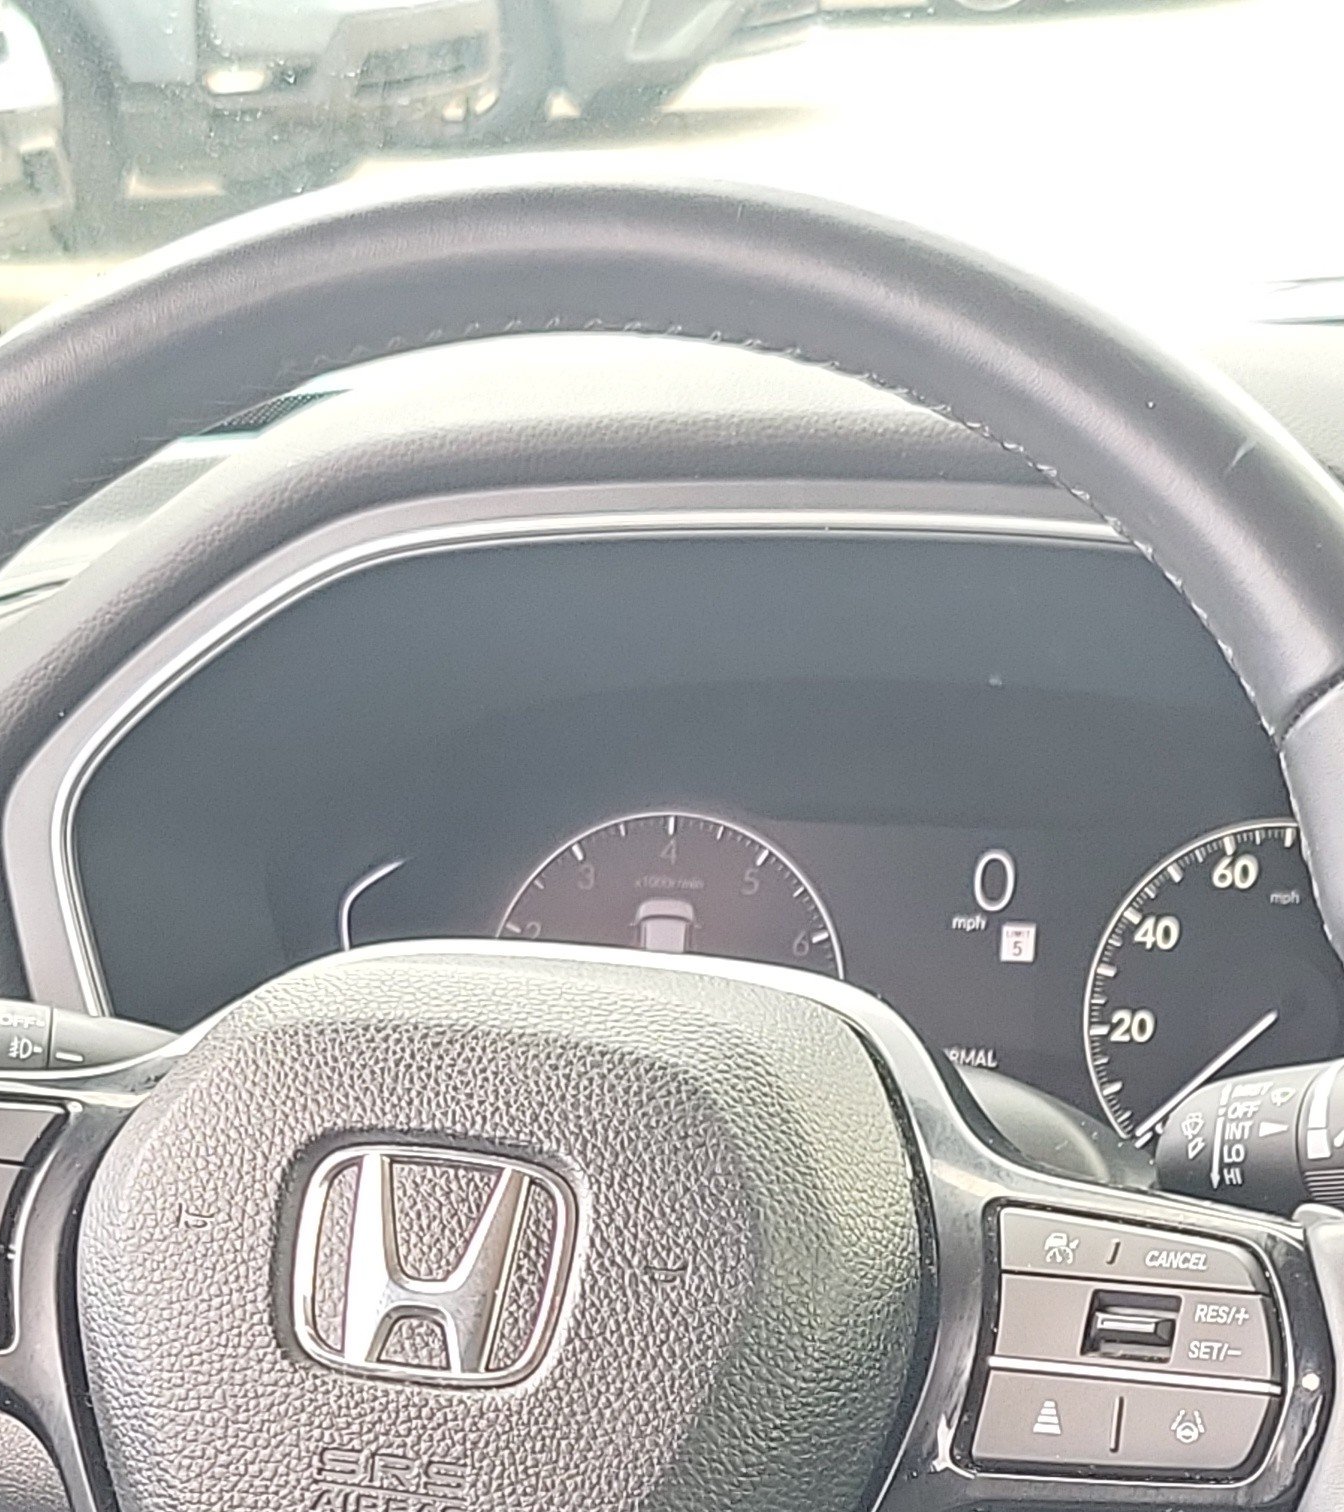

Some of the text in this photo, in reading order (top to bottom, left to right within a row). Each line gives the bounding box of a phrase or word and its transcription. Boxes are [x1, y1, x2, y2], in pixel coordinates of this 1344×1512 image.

[973, 848, 1016, 912] 0
[1211, 853, 1259, 889] 60
[1270, 890, 1300, 905] mph
[951, 913, 987, 932] mph
[1134, 916, 1180, 951] 40
[1012, 940, 1023, 957] 5
[1109, 1011, 1154, 1044] 20
[1227, 1100, 1262, 1119] OFF
[1224, 1120, 1254, 1140] INT
[1222, 1143, 1246, 1164] LO
[1222, 1166, 1244, 1186] HI
[1145, 1250, 1209, 1271] CANCEL
